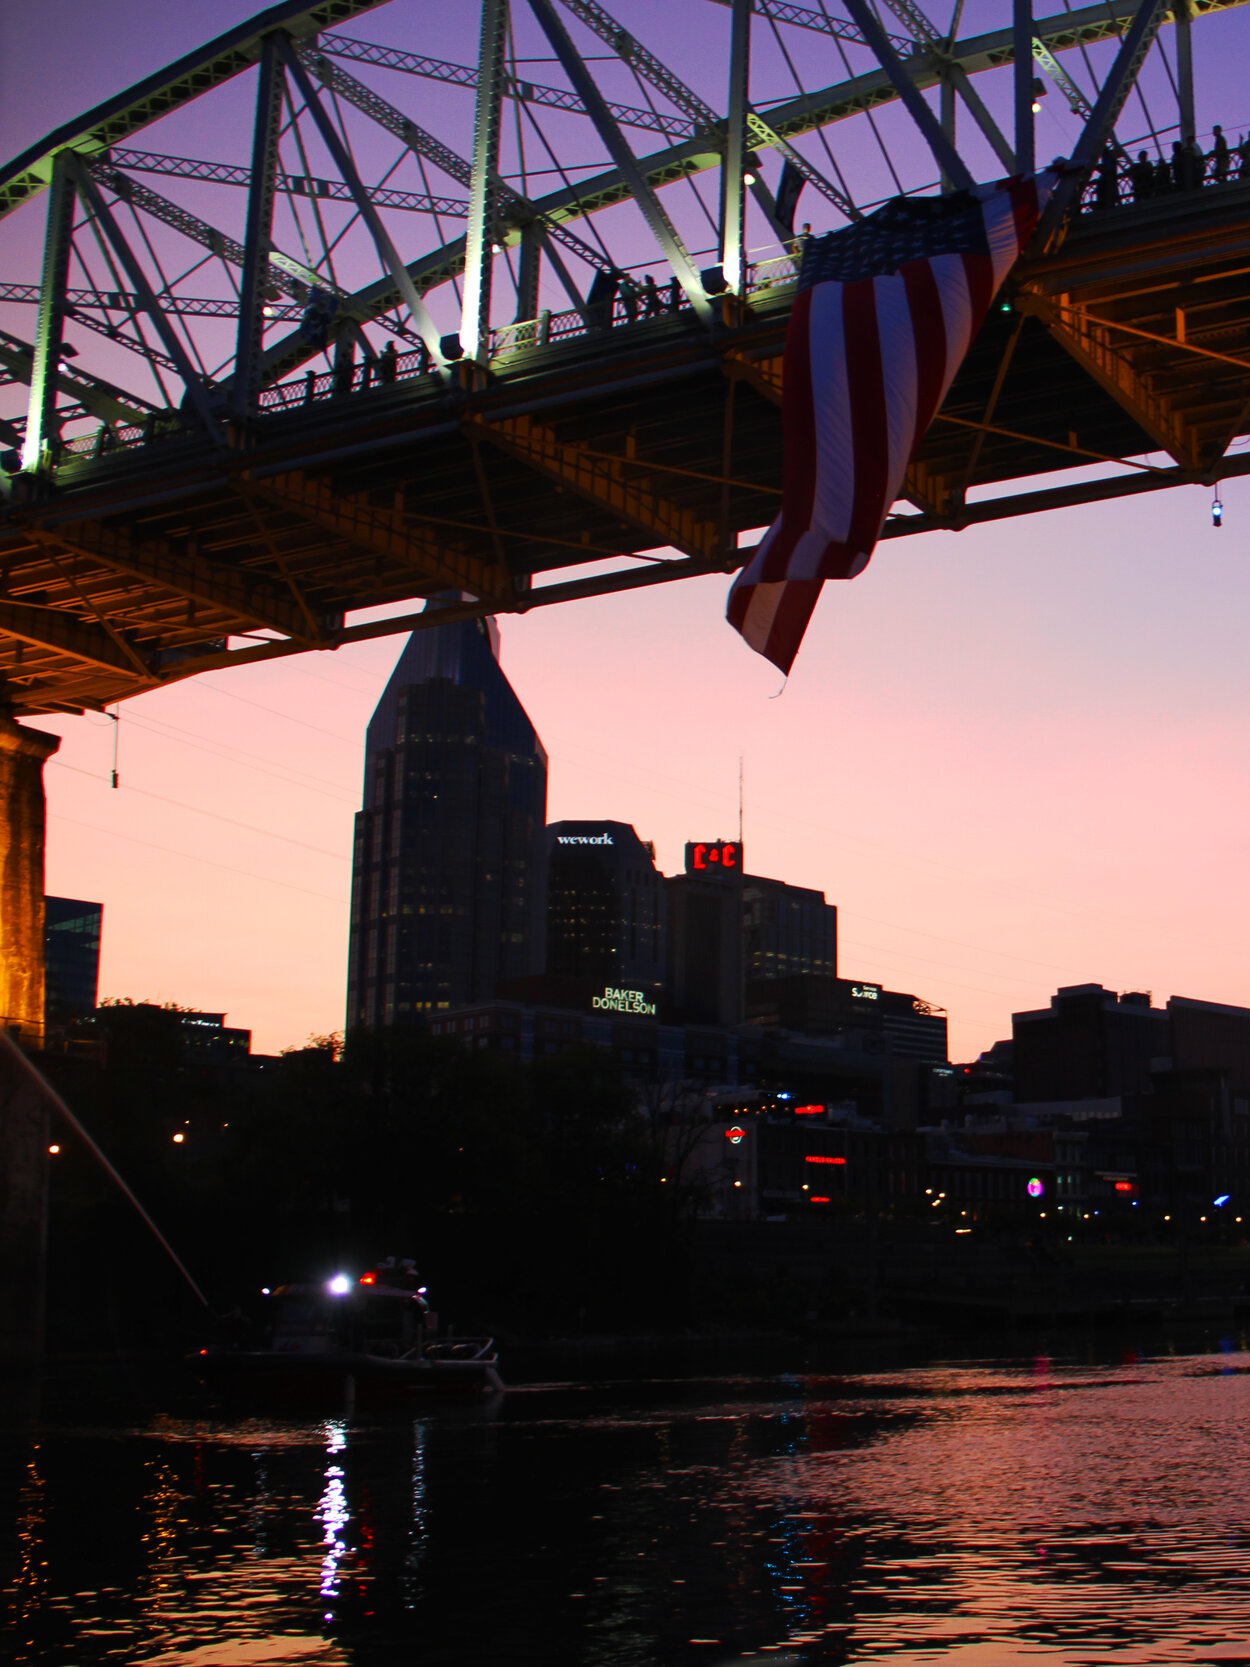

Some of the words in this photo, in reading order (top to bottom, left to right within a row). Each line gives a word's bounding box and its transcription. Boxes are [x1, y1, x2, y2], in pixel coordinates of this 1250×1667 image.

[557, 833, 614, 845] wework
[604, 987, 644, 1003] BAKER
[592, 996, 656, 1015] DONELSON
